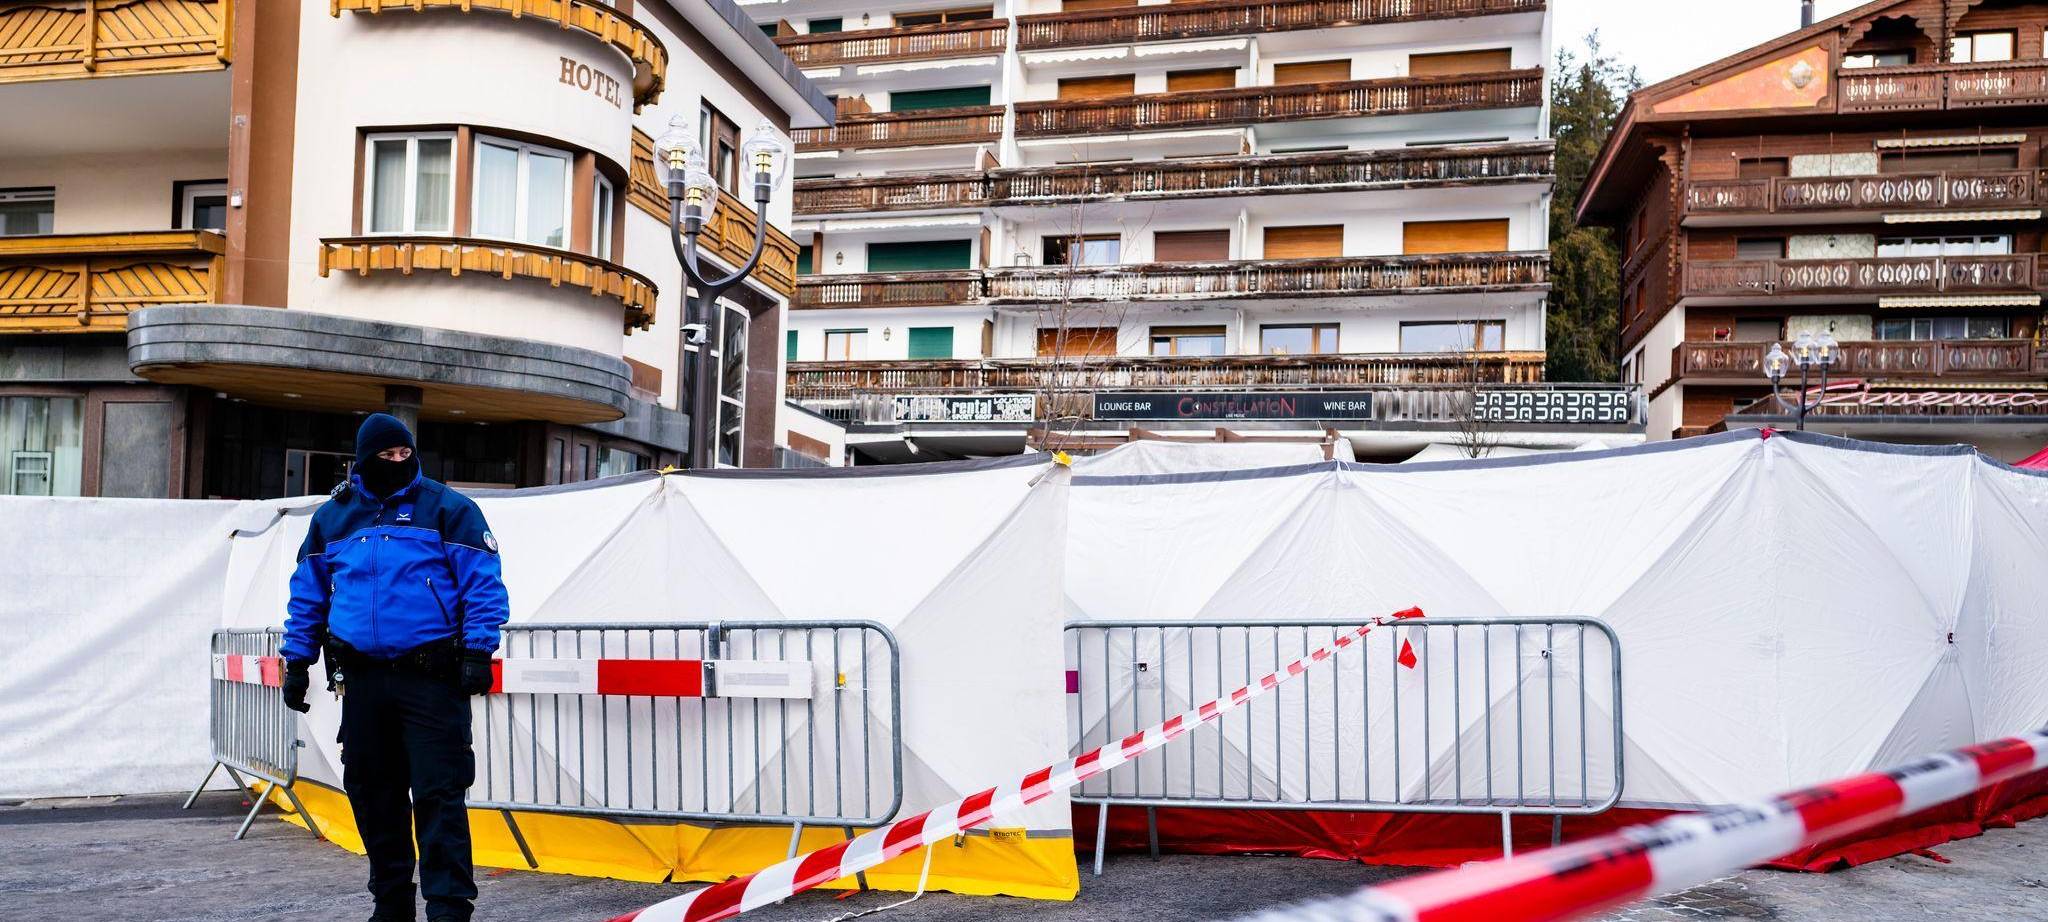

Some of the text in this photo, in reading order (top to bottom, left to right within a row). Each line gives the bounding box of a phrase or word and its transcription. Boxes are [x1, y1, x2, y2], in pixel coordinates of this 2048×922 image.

[559, 56, 622, 110] HOTEL
[1795, 379, 2048, 406] Cinema
[951, 398, 992, 415] rental
[1099, 402, 1152, 411] LOUNGE BAR
[1177, 396, 1296, 417] CONSTELLATION
[1323, 401, 1367, 411] WINE BAR
